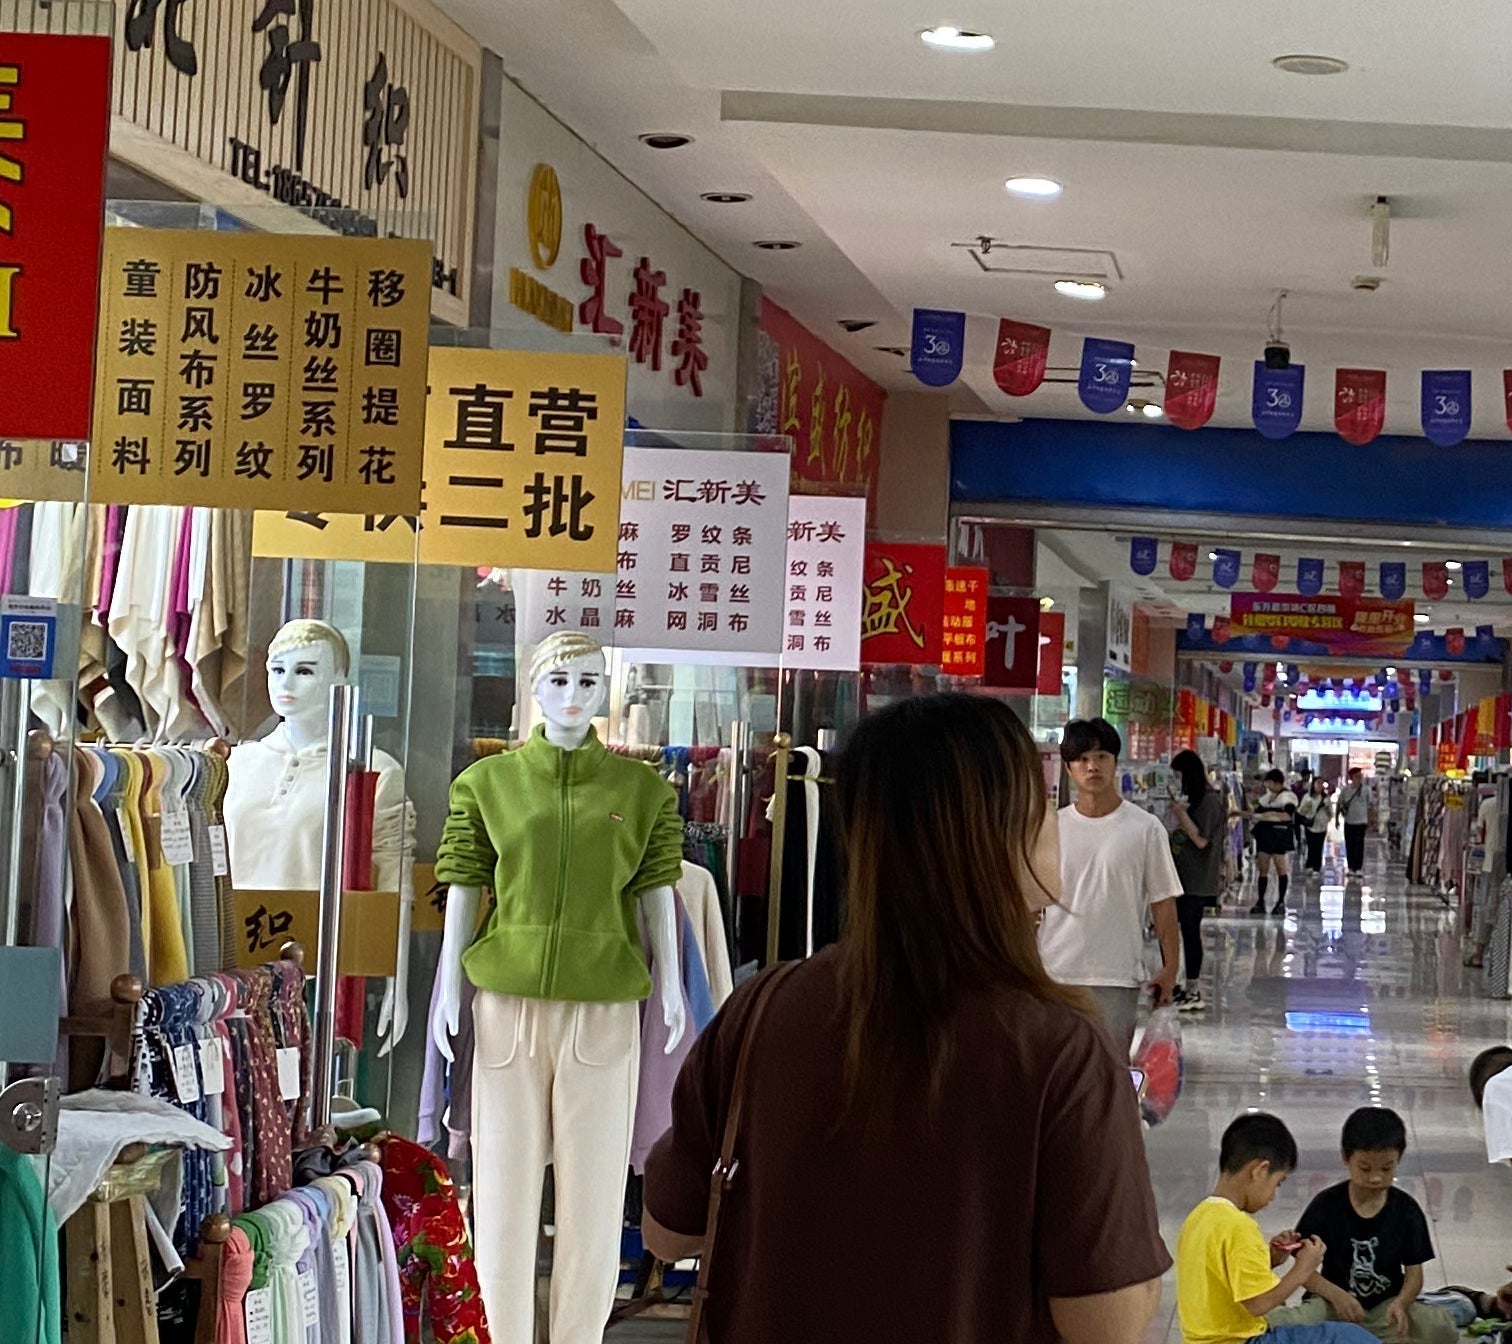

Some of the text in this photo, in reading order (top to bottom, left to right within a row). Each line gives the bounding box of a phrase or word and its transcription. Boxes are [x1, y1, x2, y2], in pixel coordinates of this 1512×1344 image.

[579, 223, 709, 398] 汇新美
[112, 259, 161, 476] 童装面料
[174, 262, 222, 478] 防风布系列
[234, 265, 282, 480] 冰丝罗纹
[297, 267, 344, 483] 牛奶丝系列
[358, 269, 406, 486] 移圈提花
[443, 384, 598, 457] 直营
[663, 479, 767, 506] 汇新美
[671, 524, 752, 545] 罗纹条
[787, 521, 845, 544] 新美
[670, 554, 751, 574] 直贡尼
[789, 561, 834, 578] 纹条
[547, 577, 750, 604] 牛奶丝 冰雪丝
[789, 586, 832, 602] 贡尼
[545, 606, 749, 633] 水晶麻 网洞布
[788, 610, 832, 627] 雪丝
[787, 634, 832, 652] 洞布
